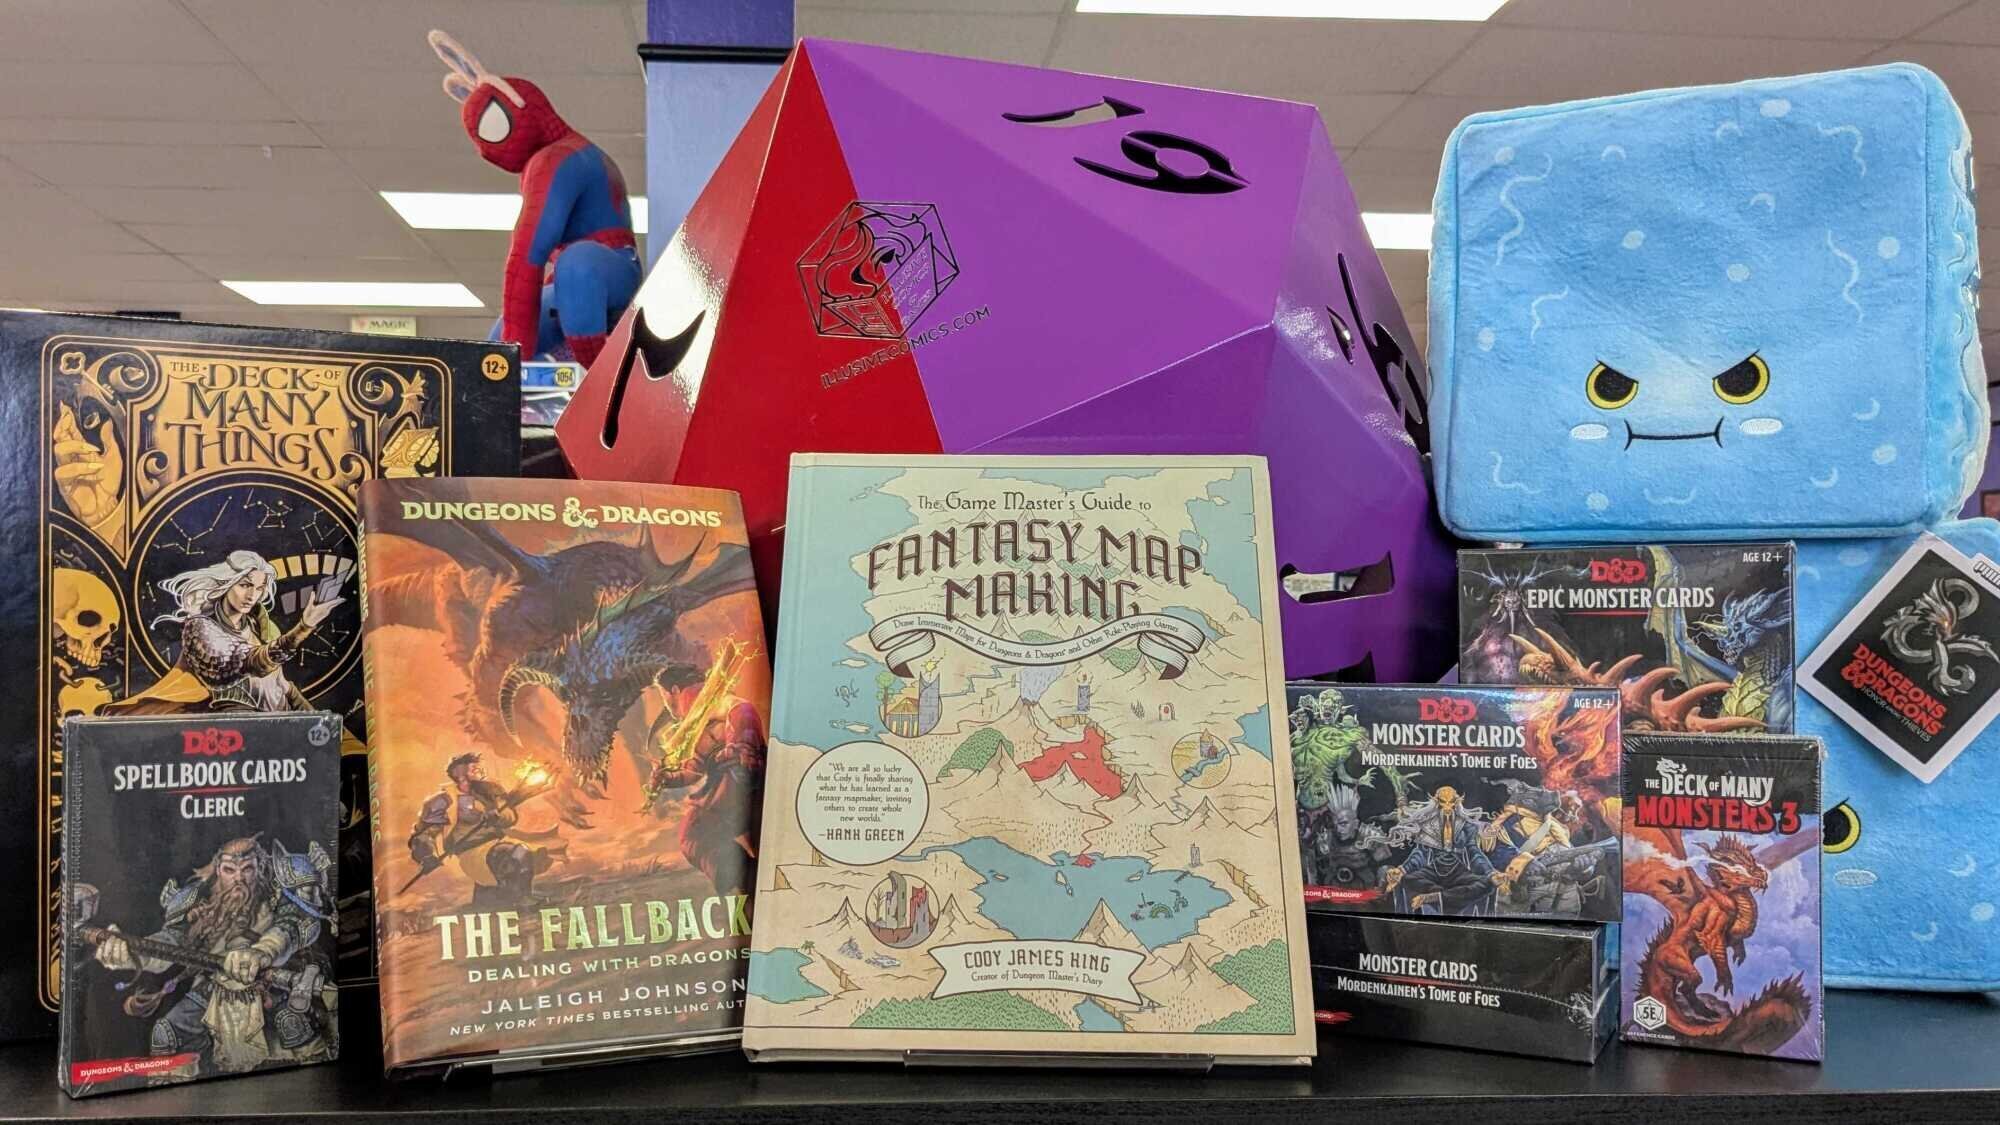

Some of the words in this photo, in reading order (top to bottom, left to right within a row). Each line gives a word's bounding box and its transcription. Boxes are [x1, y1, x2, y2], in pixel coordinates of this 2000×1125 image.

[822, 306, 991, 389] ILLUSIVECOMICS.COM
[169, 361, 200, 373] THE
[200, 363, 319, 391] DECK
[323, 370, 342, 380] OF
[485, 361, 507, 374] 12+
[183, 381, 331, 431] MANY
[165, 422, 338, 480] THINGS
[400, 501, 556, 522] DUNGEONS
[562, 497, 598, 528] &
[602, 505, 721, 527] DRAGONS
[918, 495, 941, 510] The
[945, 492, 996, 511] Game
[1003, 491, 1075, 511] Master's
[1082, 492, 1132, 511] Guide
[1138, 501, 1152, 510] to
[868, 519, 1085, 590] FANTASY
[1096, 524, 1202, 589] MAP
[1742, 553, 1760, 563] AGE
[1761, 552, 1784, 563] 12+
[1591, 558, 1647, 584] D&D
[942, 571, 1143, 621] MAKING
[1527, 588, 1566, 609] EPIC
[1568, 588, 1652, 609] MONSTER
[1655, 587, 1715, 608] CARDS
[893, 619, 914, 629] Draw
[918, 617, 954, 631] Immersive
[955, 626, 974, 642] Maps
[976, 636, 986, 647] for
[989, 640, 1022, 658] Dungeons
[1025, 650, 1031, 658] &
[1068, 644, 1081, 654] and
[1082, 636, 1103, 648] Other
[1105, 620, 1151, 638] Role-Playing
[1153, 619, 1179, 632] Games
[1854, 643, 1947, 718] DUNGEONS
[1419, 697, 1477, 723] D&D
[1574, 699, 1591, 709] AGE
[1593, 698, 1614, 710] 12+
[1841, 659, 1865, 688] &
[1863, 669, 1941, 735] DRAGONS
[182, 727, 244, 757] D&D
[310, 730, 328, 741] 12+
[1372, 723, 1461, 746] MONSTER
[1465, 724, 1526, 748] CARDS
[1901, 716, 1932, 742] THIEVES
[862, 764, 870, 772] all
[884, 763, 902, 773] lucky
[1361, 751, 1458, 768] MORDENKAINEN'S
[1460, 753, 1491, 768] TOME
[1494, 756, 1507, 769] OF
[1510, 754, 1537, 769] FOES
[114, 760, 237, 791] SPELLBOOK
[241, 758, 307, 785] CARDS
[816, 774, 831, 782] that
[834, 772, 852, 783] Cody
[863, 774, 885, 783] finally
[888, 774, 913, 784] sharing
[1645, 779, 1660, 789] THE
[1657, 765, 1709, 797] DECK
[1709, 781, 1720, 791] OF
[1721, 775, 1774, 806] MANY
[815, 794, 841, 802] fantasy
[819, 784, 836, 792] what
[840, 784, 848, 792] he
[851, 784, 862, 792] has
[866, 784, 891, 792] learned
[180, 794, 245, 819] CLERIC
[824, 804, 845, 812] others
[881, 804, 902, 812] whole
[1638, 796, 1774, 832] MONSTERS
[1782, 802, 1798, 832] 3
[865, 828, 905, 841] GREEN
[433, 911, 522, 960] THE
[539, 894, 752, 953] FALLBACK
[468, 961, 573, 983] DEALING
[583, 955, 639, 974] WITH
[650, 948, 752, 967] DRAGONS
[964, 950, 1001, 969] CODY
[1008, 949, 1064, 966] JAMES
[1070, 951, 1111, 973] KING
[1359, 952, 1427, 977] MONSTER
[1430, 960, 1478, 982] CARDS
[971, 971, 998, 982] Creator
[1001, 970, 1009, 981] of
[1012, 969, 1045, 981] Dungeon
[1048, 970, 1079, 983] Master's
[1082, 973, 1104, 987] Diary
[481, 990, 603, 1015] JALEIGH
[619, 978, 746, 1001] JOHNSON
[1337, 975, 1426, 999] MORDENKAINEN'S
[1428, 986, 1456, 1003] TOME
[1458, 991, 1472, 1004] OF
[1474, 990, 1501, 1008] FOES
[449, 1022, 487, 1036] NEW
[494, 1018, 537, 1032] YORK
[546, 1012, 596, 1026] TIMES
[603, 1002, 710, 1020] BESTSELLING
[716, 999, 745, 1011] AUT
[1642, 1007, 1657, 1020] 5E
[80, 1065, 122, 1077] DUNGEONS
[123, 1062, 134, 1073] &
[134, 1060, 170, 1070] DRAGONS
